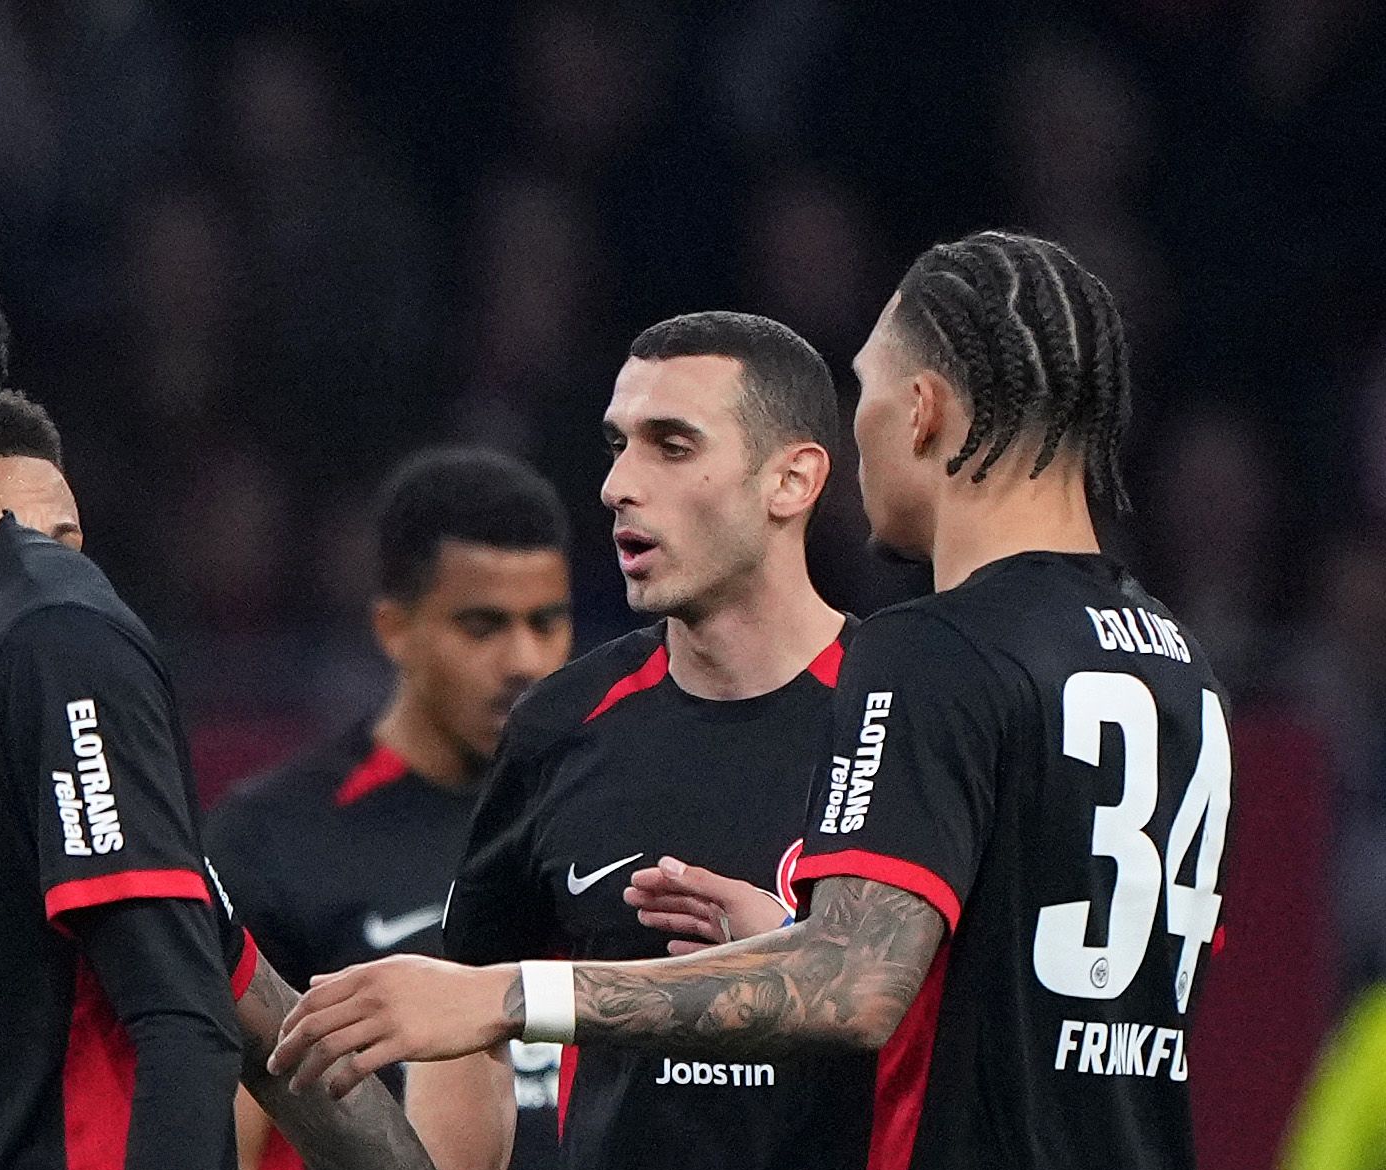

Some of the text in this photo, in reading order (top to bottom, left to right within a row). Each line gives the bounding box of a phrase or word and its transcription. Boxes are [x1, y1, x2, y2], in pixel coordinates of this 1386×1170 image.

[1085, 606, 1192, 664] COLLINS
[66, 699, 124, 855] ELOTRANS
[819, 755, 851, 834] reload
[840, 691, 893, 834] ELOTRANS
[52, 770, 93, 856] reload
[1034, 671, 1232, 1014] 34
[655, 1057, 775, 1087] Jobs fin
[1055, 1019, 1188, 1082] FRANKFU
